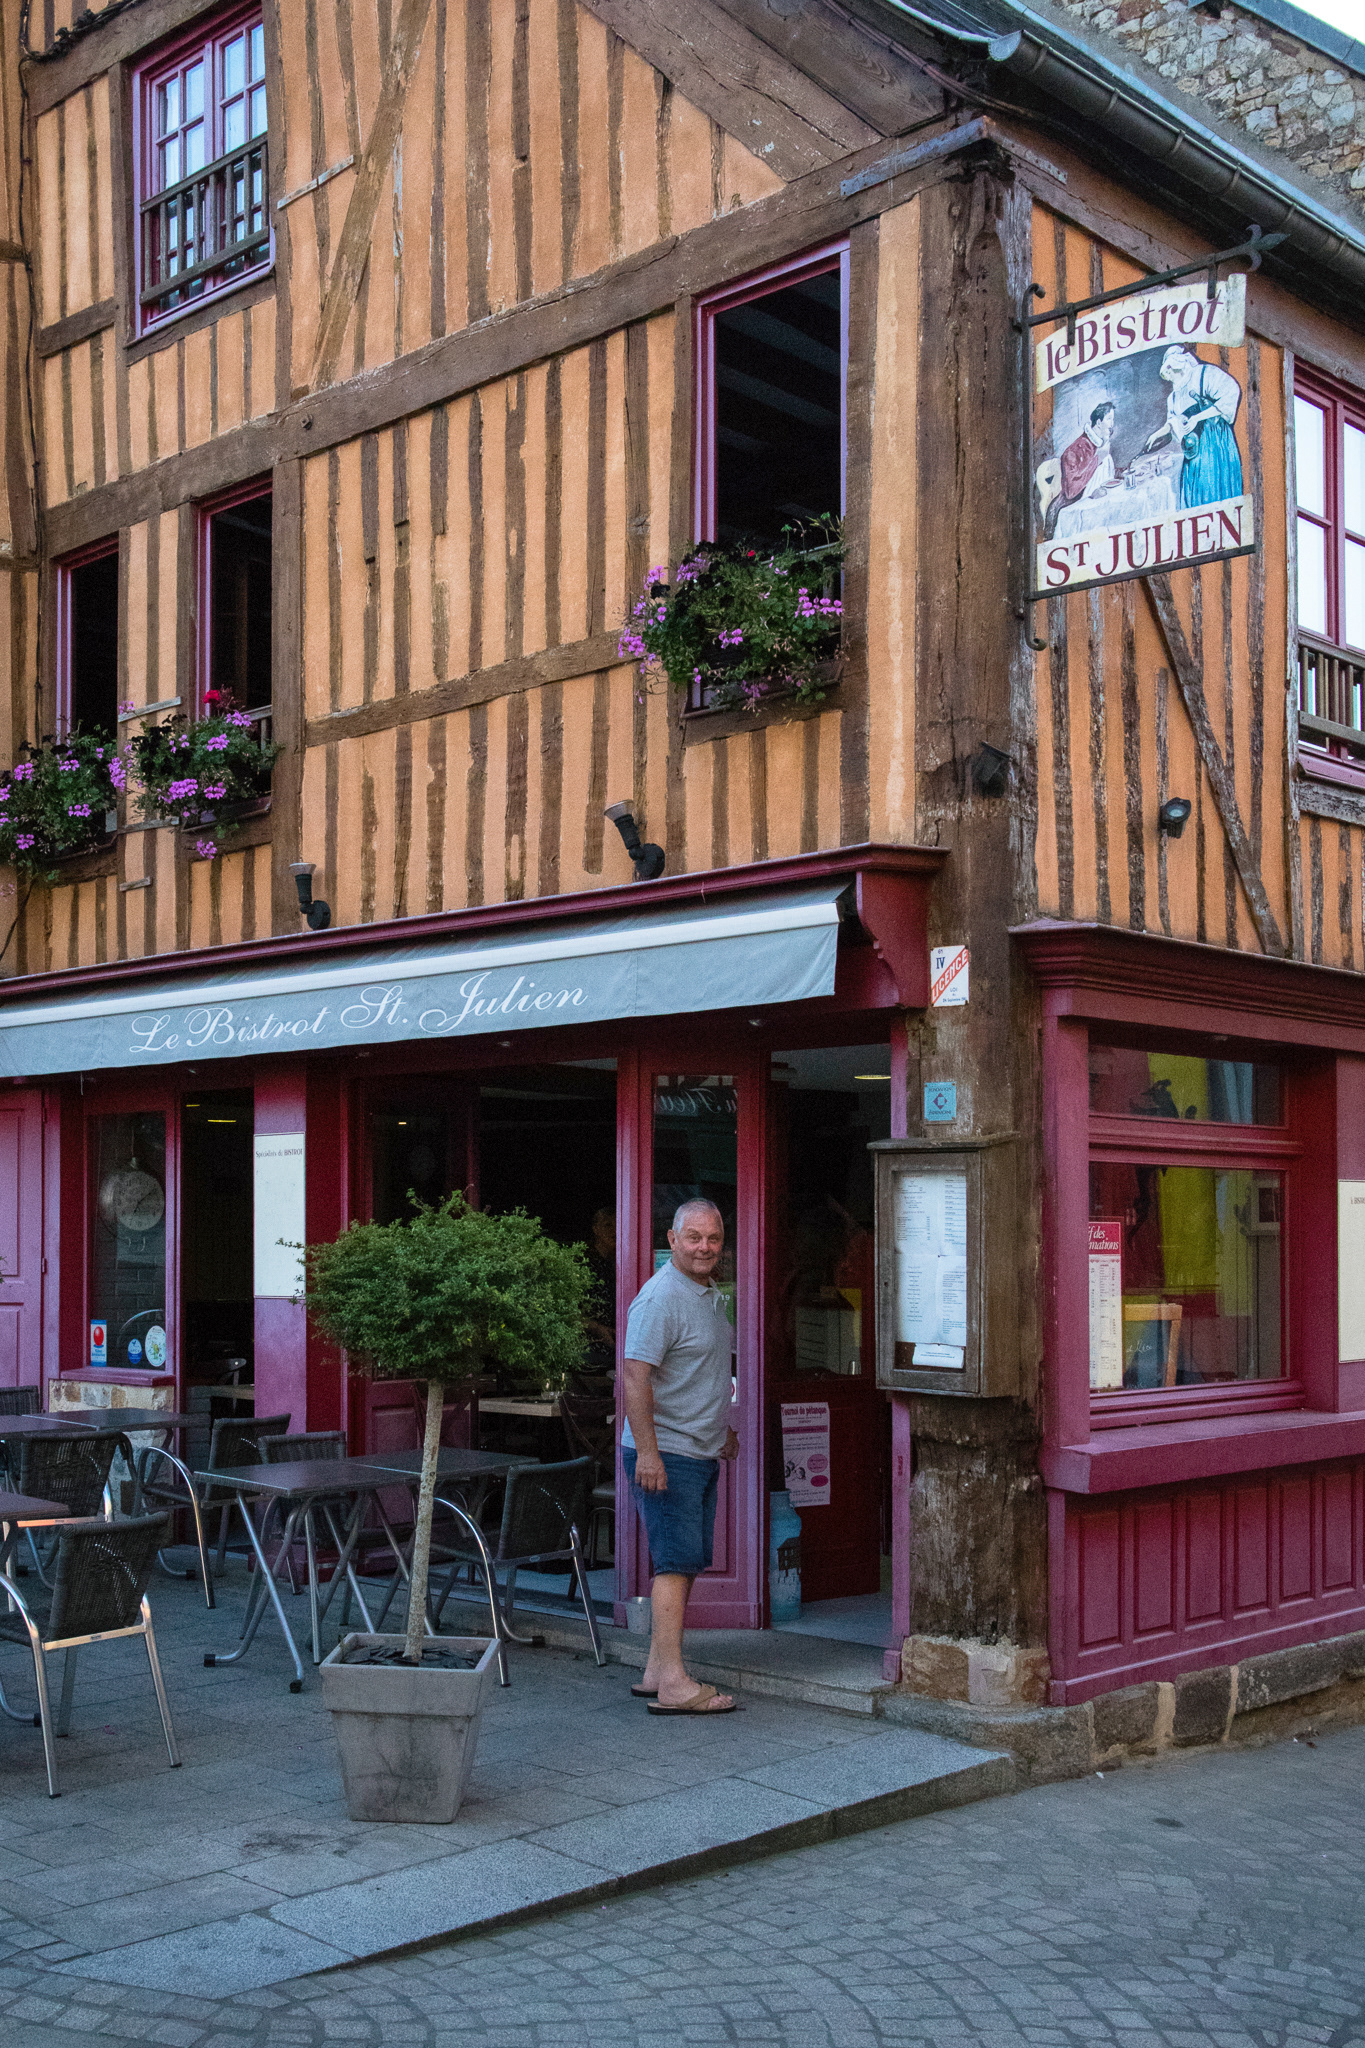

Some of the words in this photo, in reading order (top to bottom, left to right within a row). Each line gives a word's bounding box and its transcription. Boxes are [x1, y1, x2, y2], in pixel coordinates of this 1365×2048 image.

[1045, 340, 1071, 382] le
[1075, 290, 1224, 367] Bistrot
[1095, 505, 1244, 577] JULIEN
[931, 949, 969, 1004] LICENCE
[935, 956, 946, 970] IV
[129, 1014, 180, 1053] Le
[184, 1006, 331, 1047] Bistrot
[340, 985, 408, 1029] St.
[419, 971, 589, 1034] Julien
